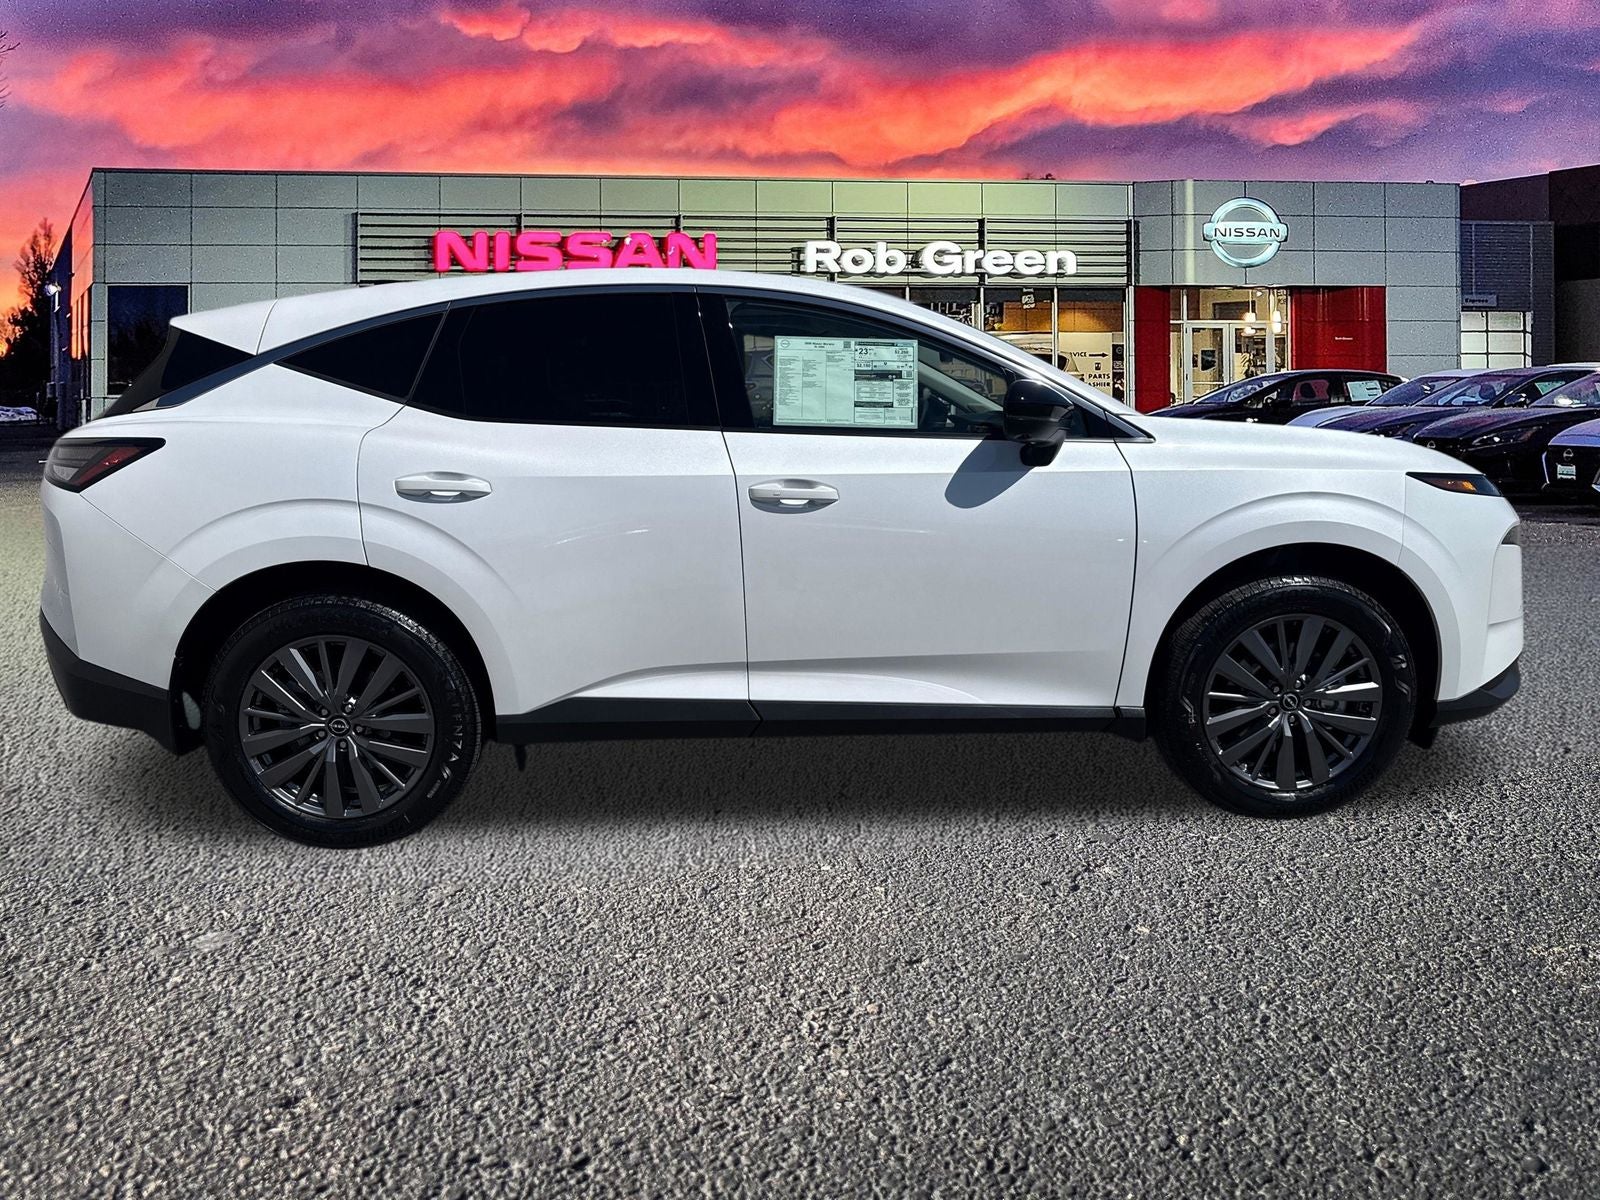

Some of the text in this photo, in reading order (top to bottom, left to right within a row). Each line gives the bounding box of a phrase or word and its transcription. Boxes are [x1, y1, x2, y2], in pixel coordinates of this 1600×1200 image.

[1214, 227, 1281, 238] NISSAN
[434, 230, 718, 271] NISSAN
[804, 240, 1078, 275] Rob Green
[858, 347, 869, 355] 23
